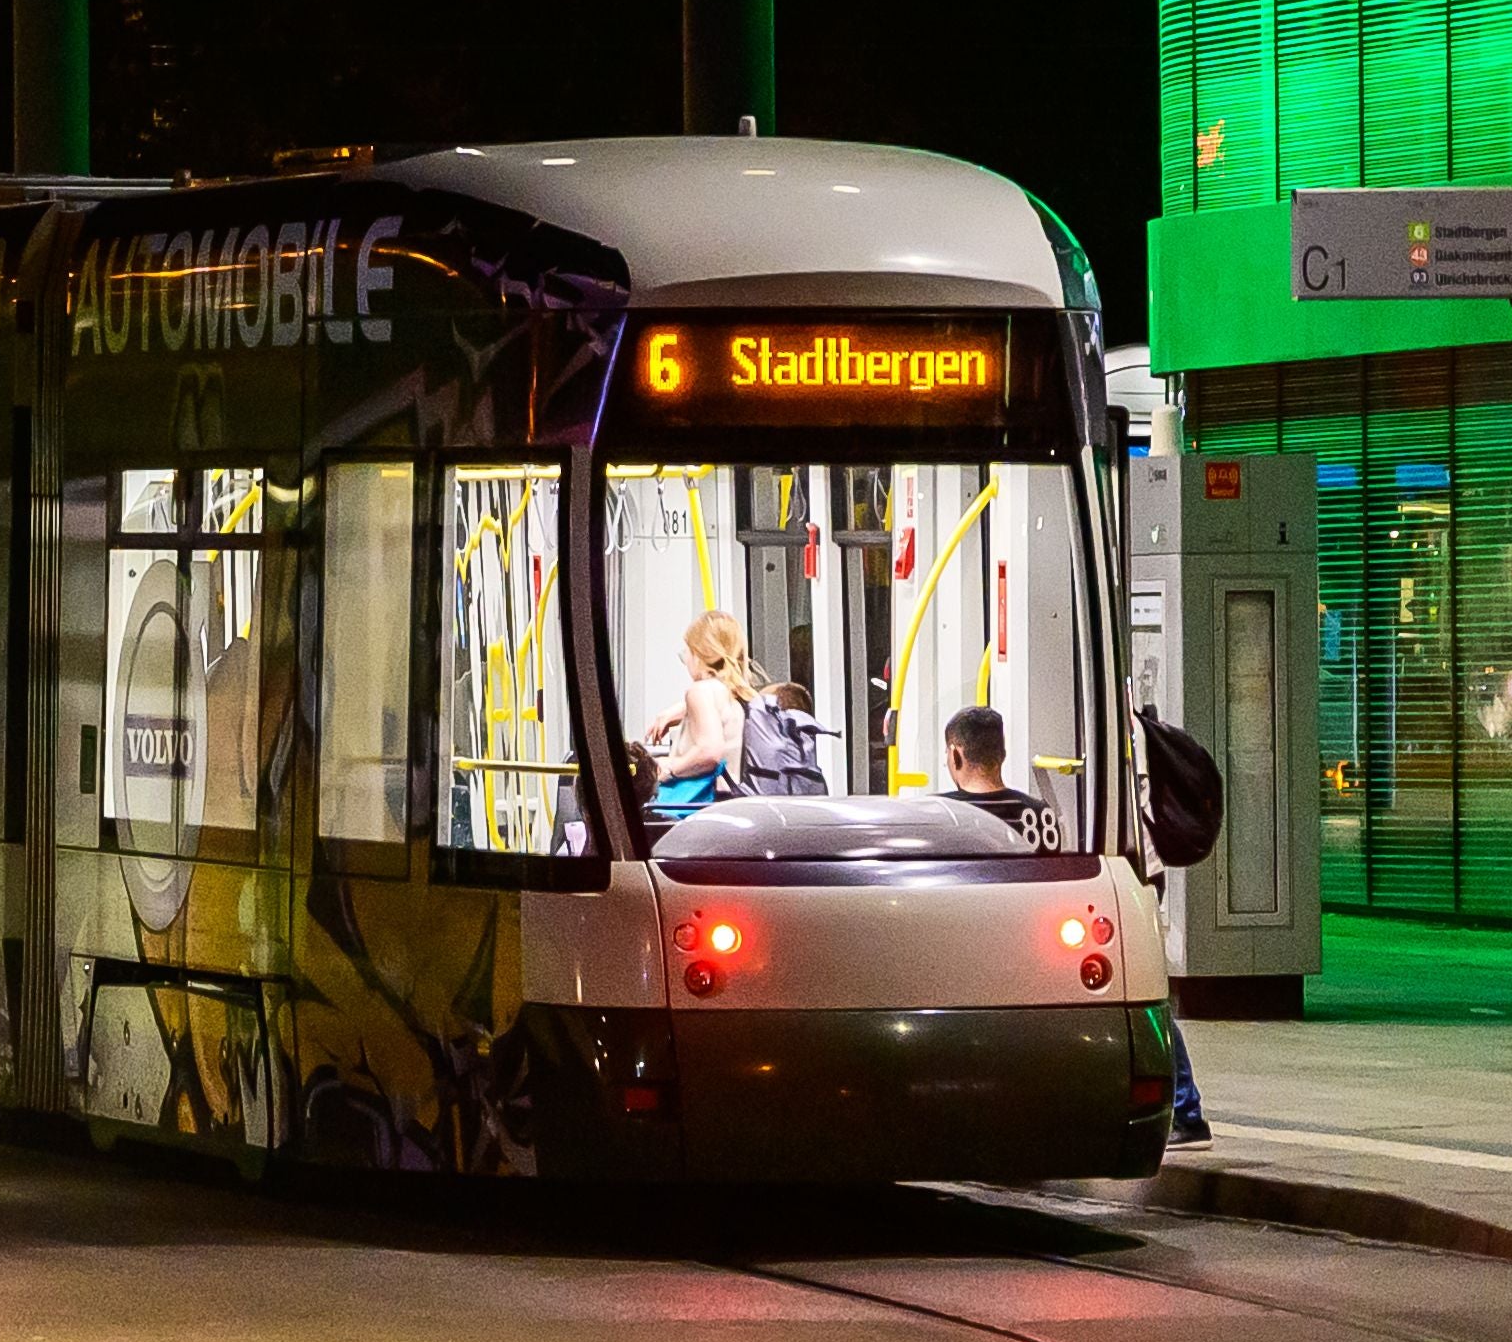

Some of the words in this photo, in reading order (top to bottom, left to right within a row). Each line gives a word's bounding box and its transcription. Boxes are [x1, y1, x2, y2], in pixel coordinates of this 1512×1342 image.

[72, 215, 404, 357] AUTOMOBILE
[1302, 245, 1347, 292] C1
[649, 333, 681, 392] 6
[731, 337, 986, 390] Stadtbergen
[126, 728, 194, 768] VOLVO
[1020, 807, 1059, 851] 88
